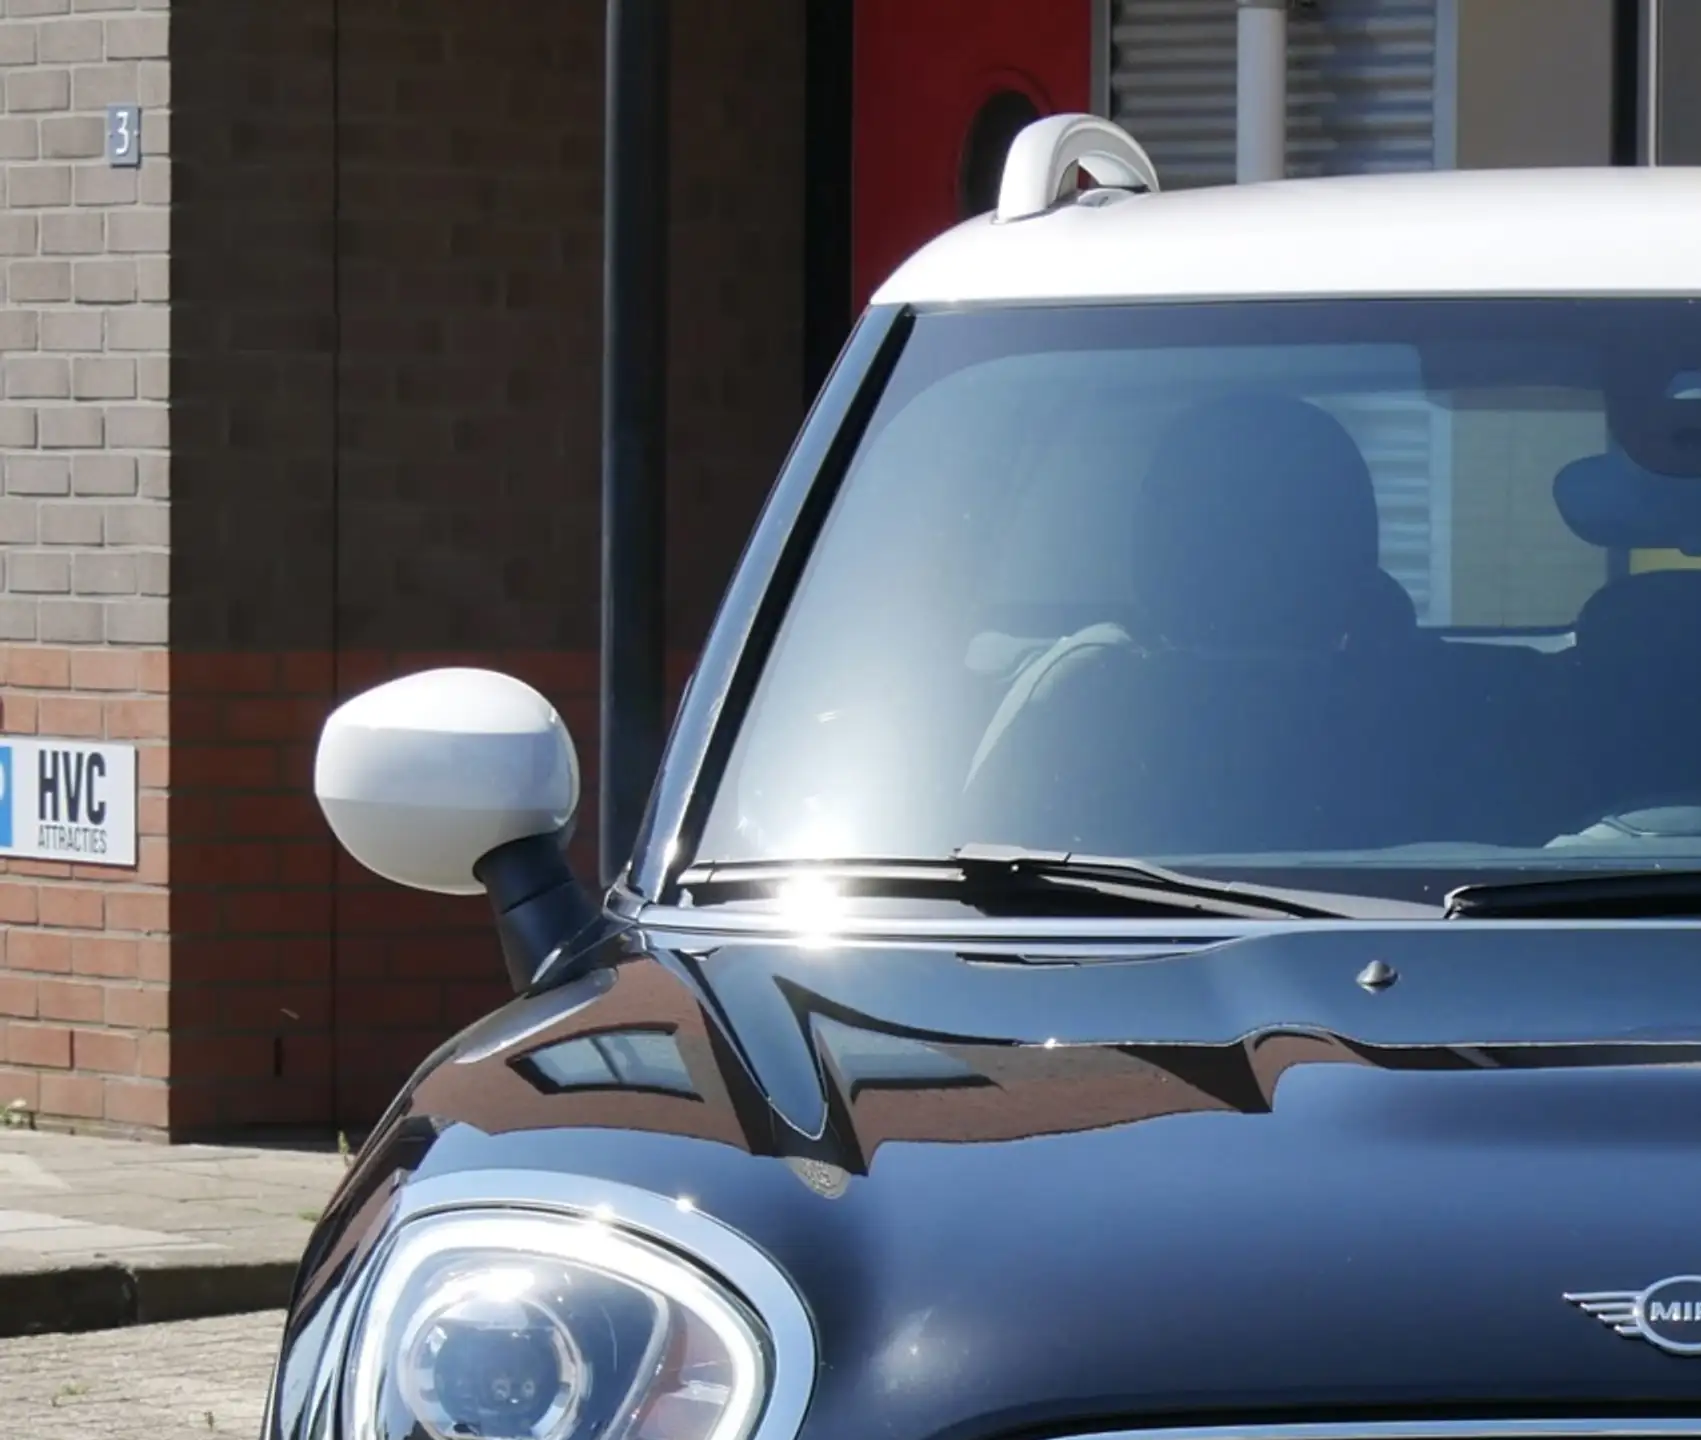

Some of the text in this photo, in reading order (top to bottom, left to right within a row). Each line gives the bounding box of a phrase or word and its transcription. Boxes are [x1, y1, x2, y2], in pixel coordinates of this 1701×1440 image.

[115, 111, 129, 155] 3
[38, 749, 106, 826] HVC
[38, 824, 108, 854] ATTRACTIES
